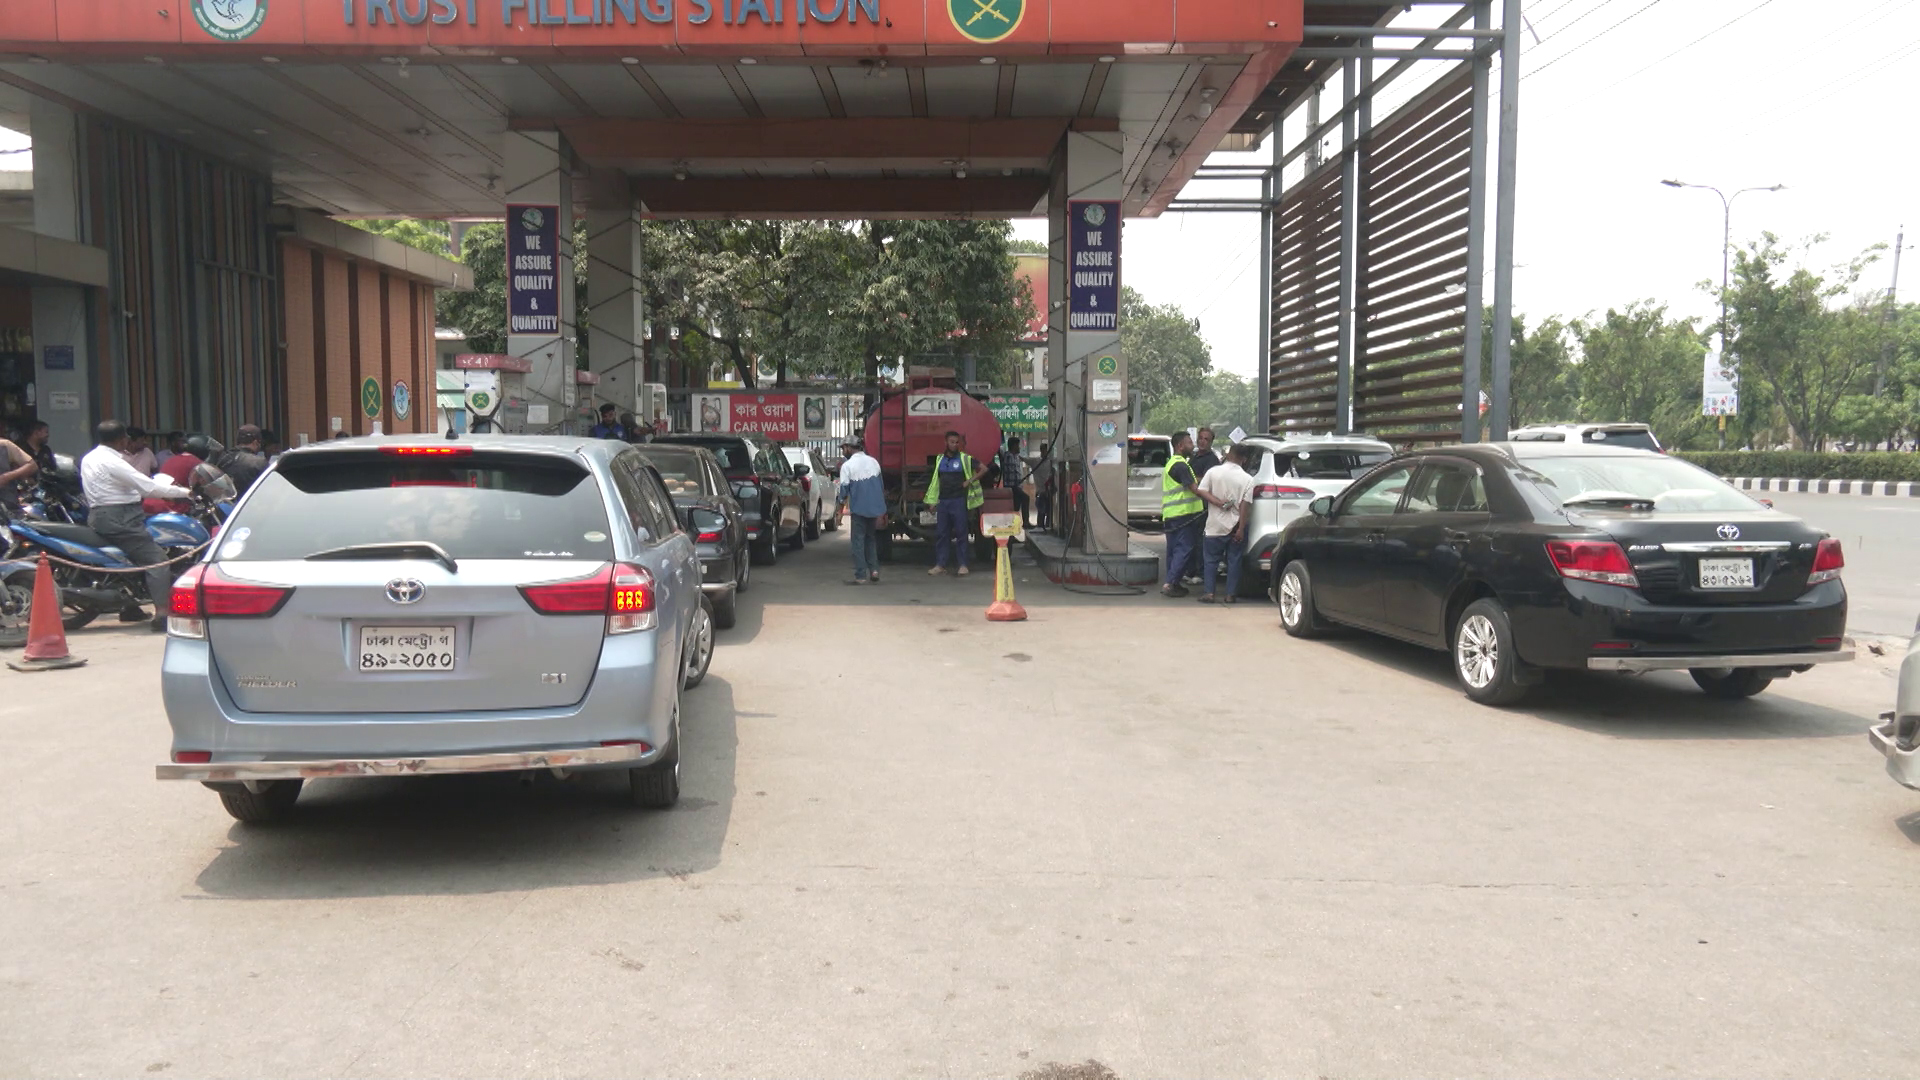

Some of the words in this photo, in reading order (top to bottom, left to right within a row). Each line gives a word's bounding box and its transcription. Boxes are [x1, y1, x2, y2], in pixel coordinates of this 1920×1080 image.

[525, 235, 541, 250] WE
[1087, 231, 1102, 246] WE
[515, 255, 552, 270] ASSURE
[1076, 251, 1112, 266] ASSURE
[514, 275, 553, 291] QUALITY
[1075, 271, 1114, 287] QUALITY
[530, 297, 538, 310] &
[1089, 293, 1098, 307] &
[511, 315, 557, 331] QUANTITY
[1070, 312, 1117, 327] QUANTITY
[734, 403, 758, 417] কার
[762, 403, 794, 417] ওয়াশ
[733, 421, 758, 432] CAR
[761, 421, 795, 432] WASH
[366, 635, 394, 647] ঢাকা
